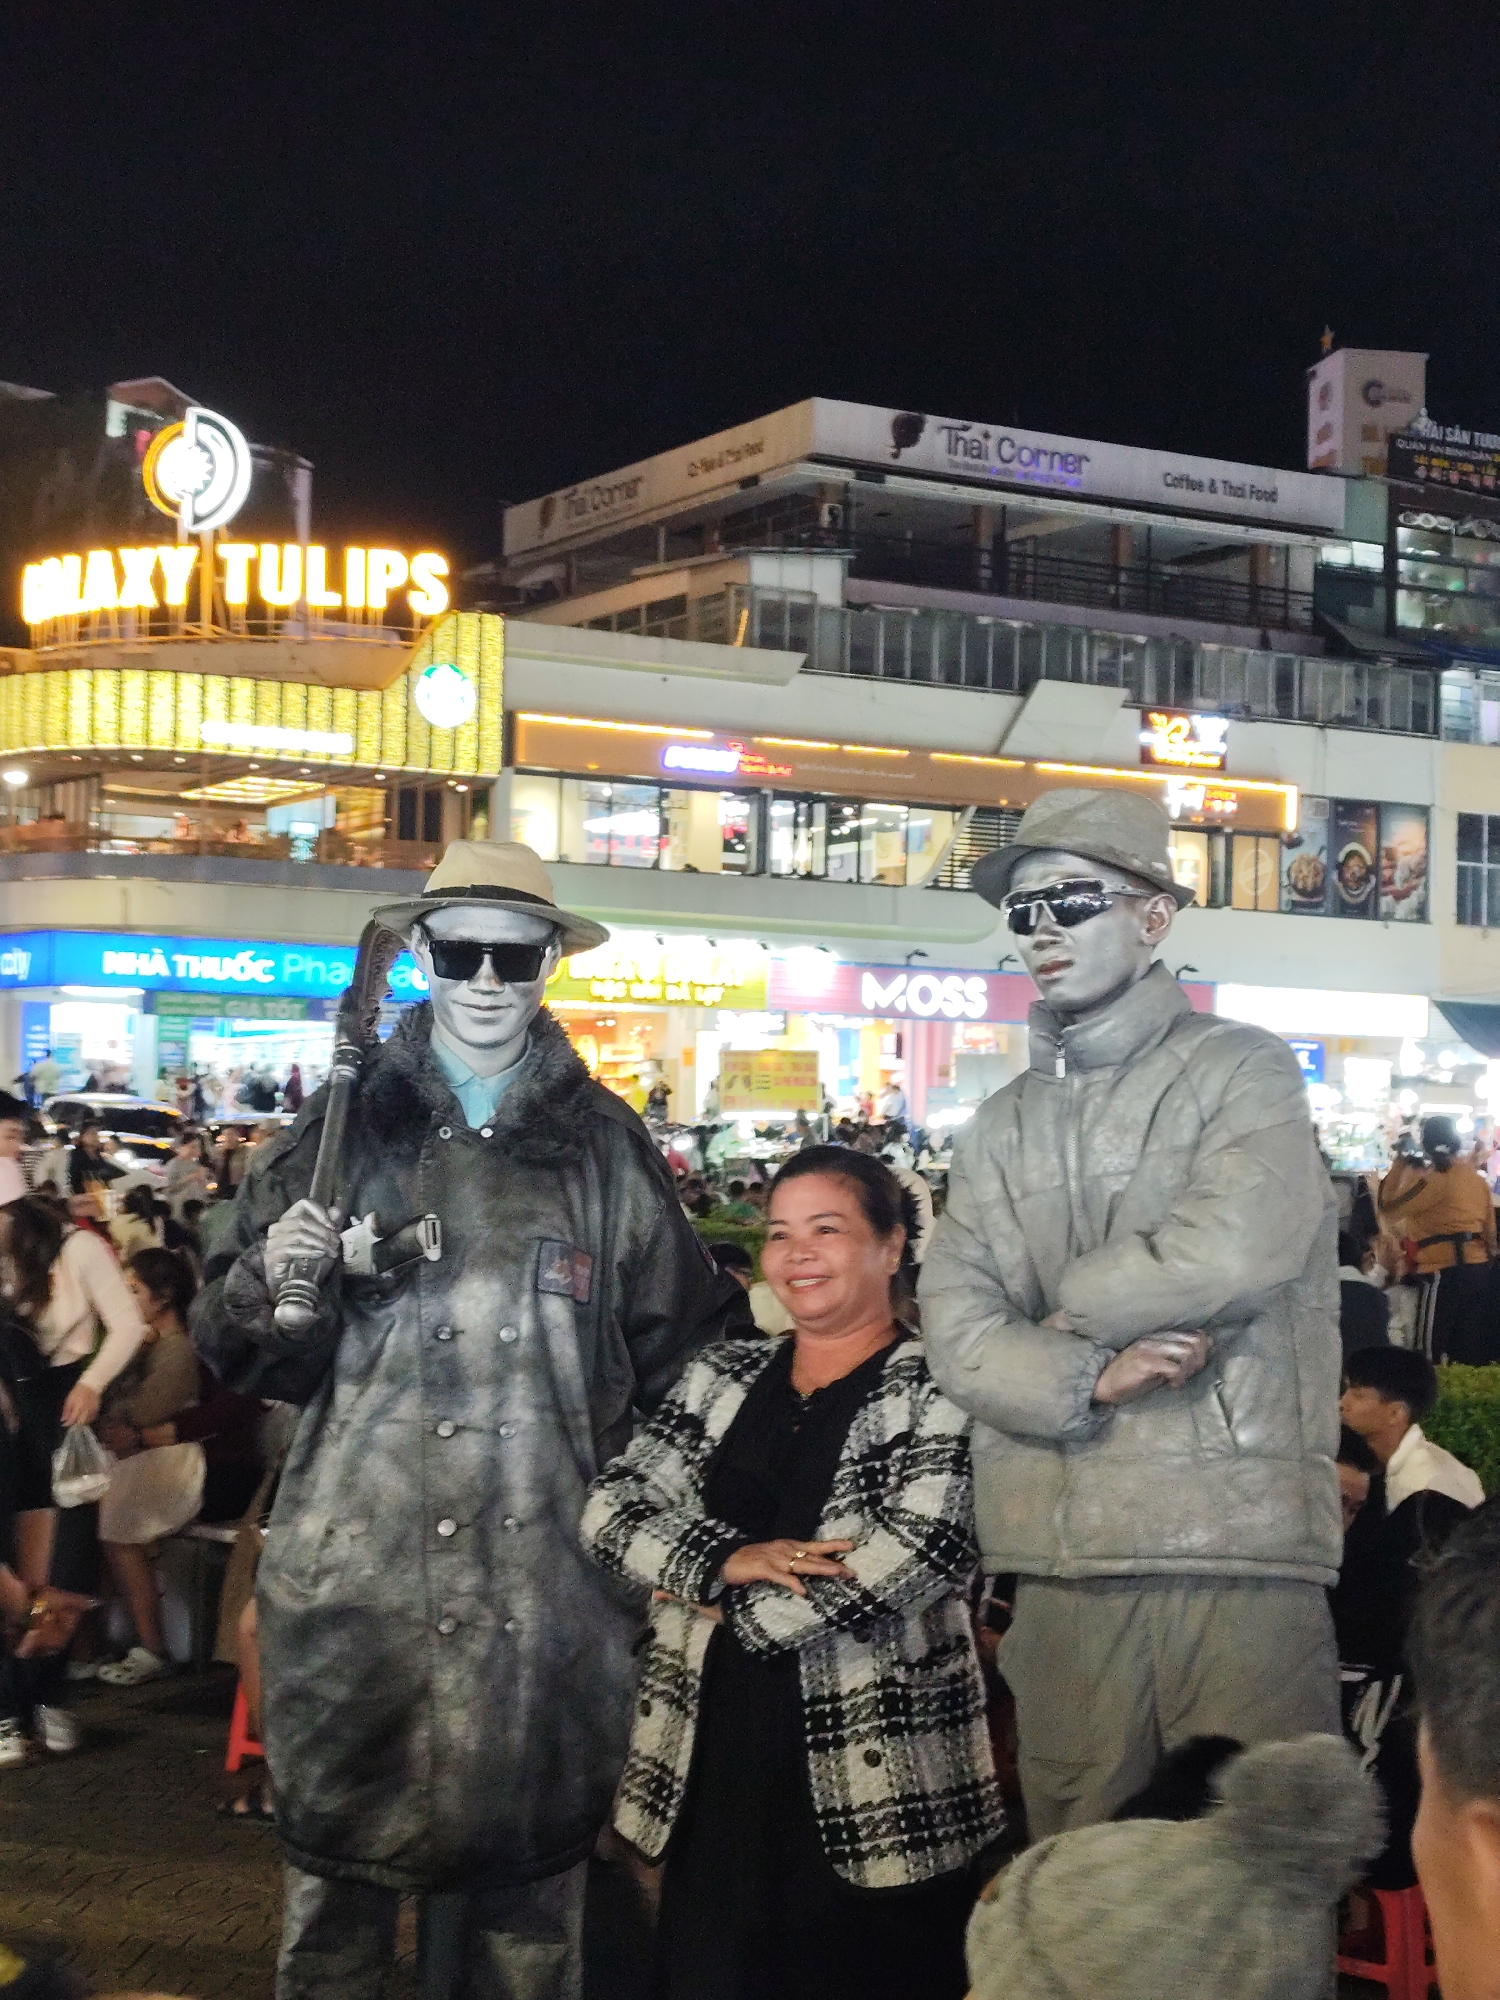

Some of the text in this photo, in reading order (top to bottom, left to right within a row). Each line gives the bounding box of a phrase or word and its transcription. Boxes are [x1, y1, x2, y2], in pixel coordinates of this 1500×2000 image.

[937, 424, 991, 461] Thai
[997, 436, 1090, 475] Corner
[1162, 472, 1204, 492] Coffee
[1249, 484, 1278, 503] Food
[216, 543, 450, 616] TULIPS
[102, 948, 171, 977] NHÀ
[172, 951, 276, 983] THUỐC
[861, 972, 988, 1019] MOSS
